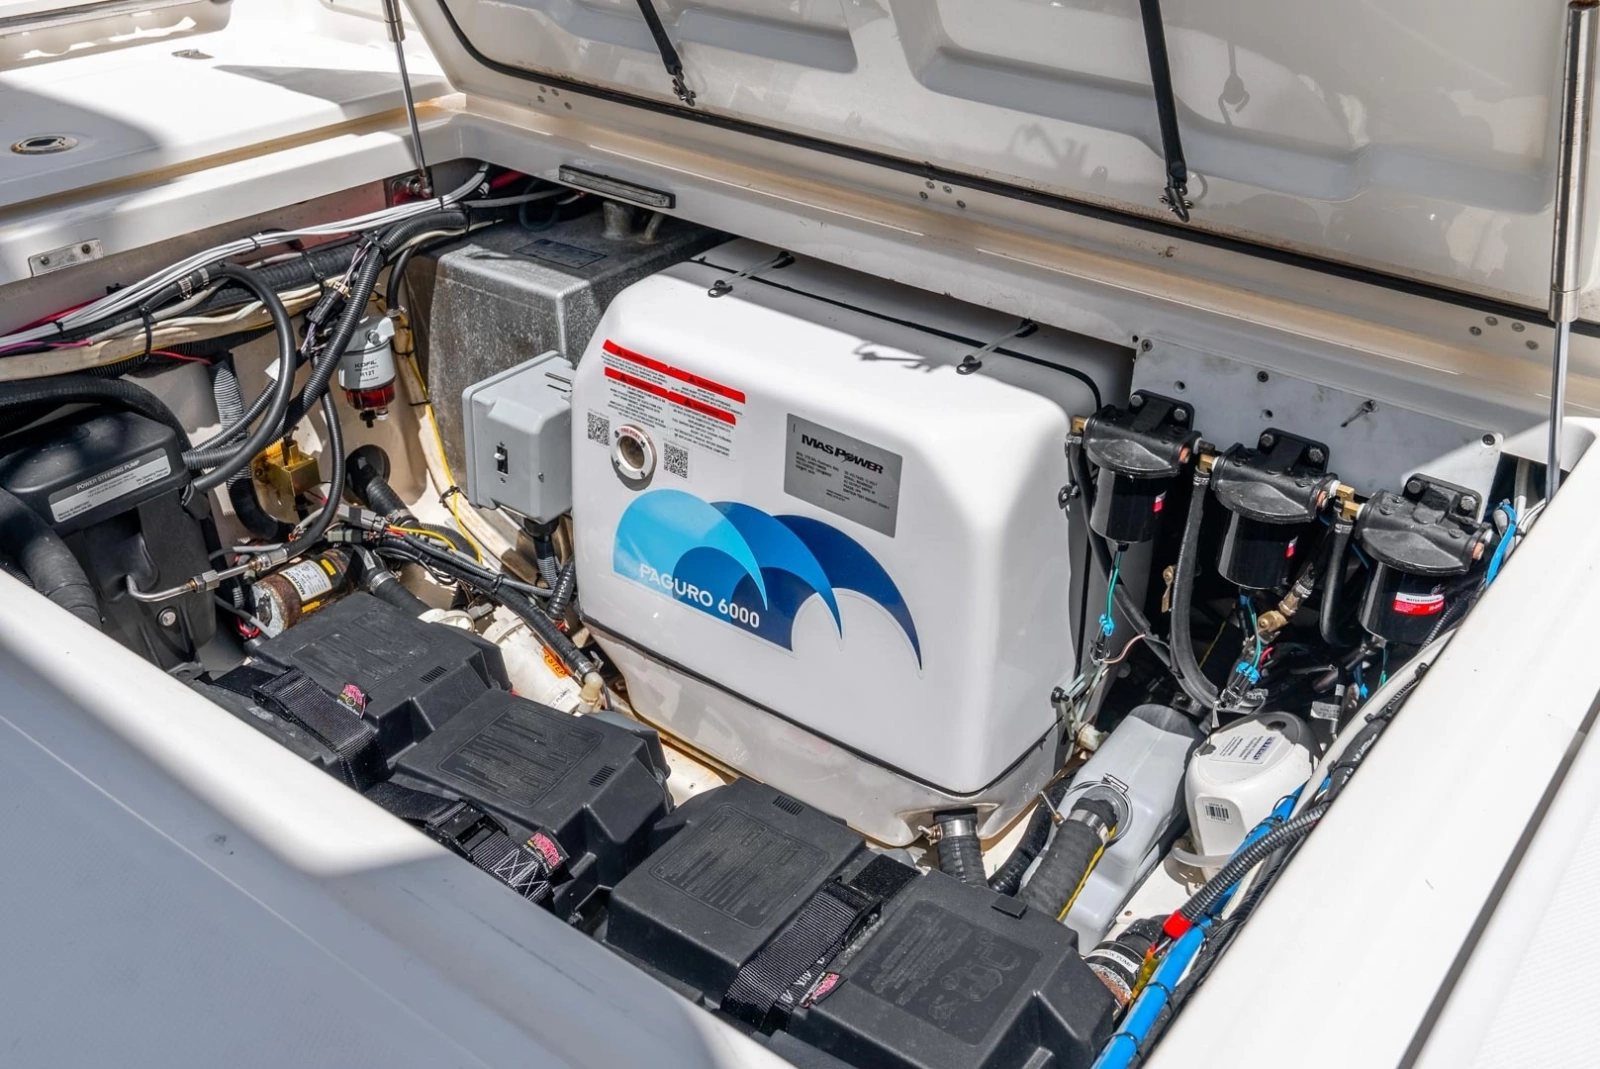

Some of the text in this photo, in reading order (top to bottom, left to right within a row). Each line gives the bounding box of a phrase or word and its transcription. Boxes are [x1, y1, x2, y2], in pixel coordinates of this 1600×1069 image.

[76, 478, 97, 490] POWER
[98, 467, 124, 482] STEERING
[124, 460, 140, 470] PUMP
[640, 563, 760, 628] PAGURO 6000
